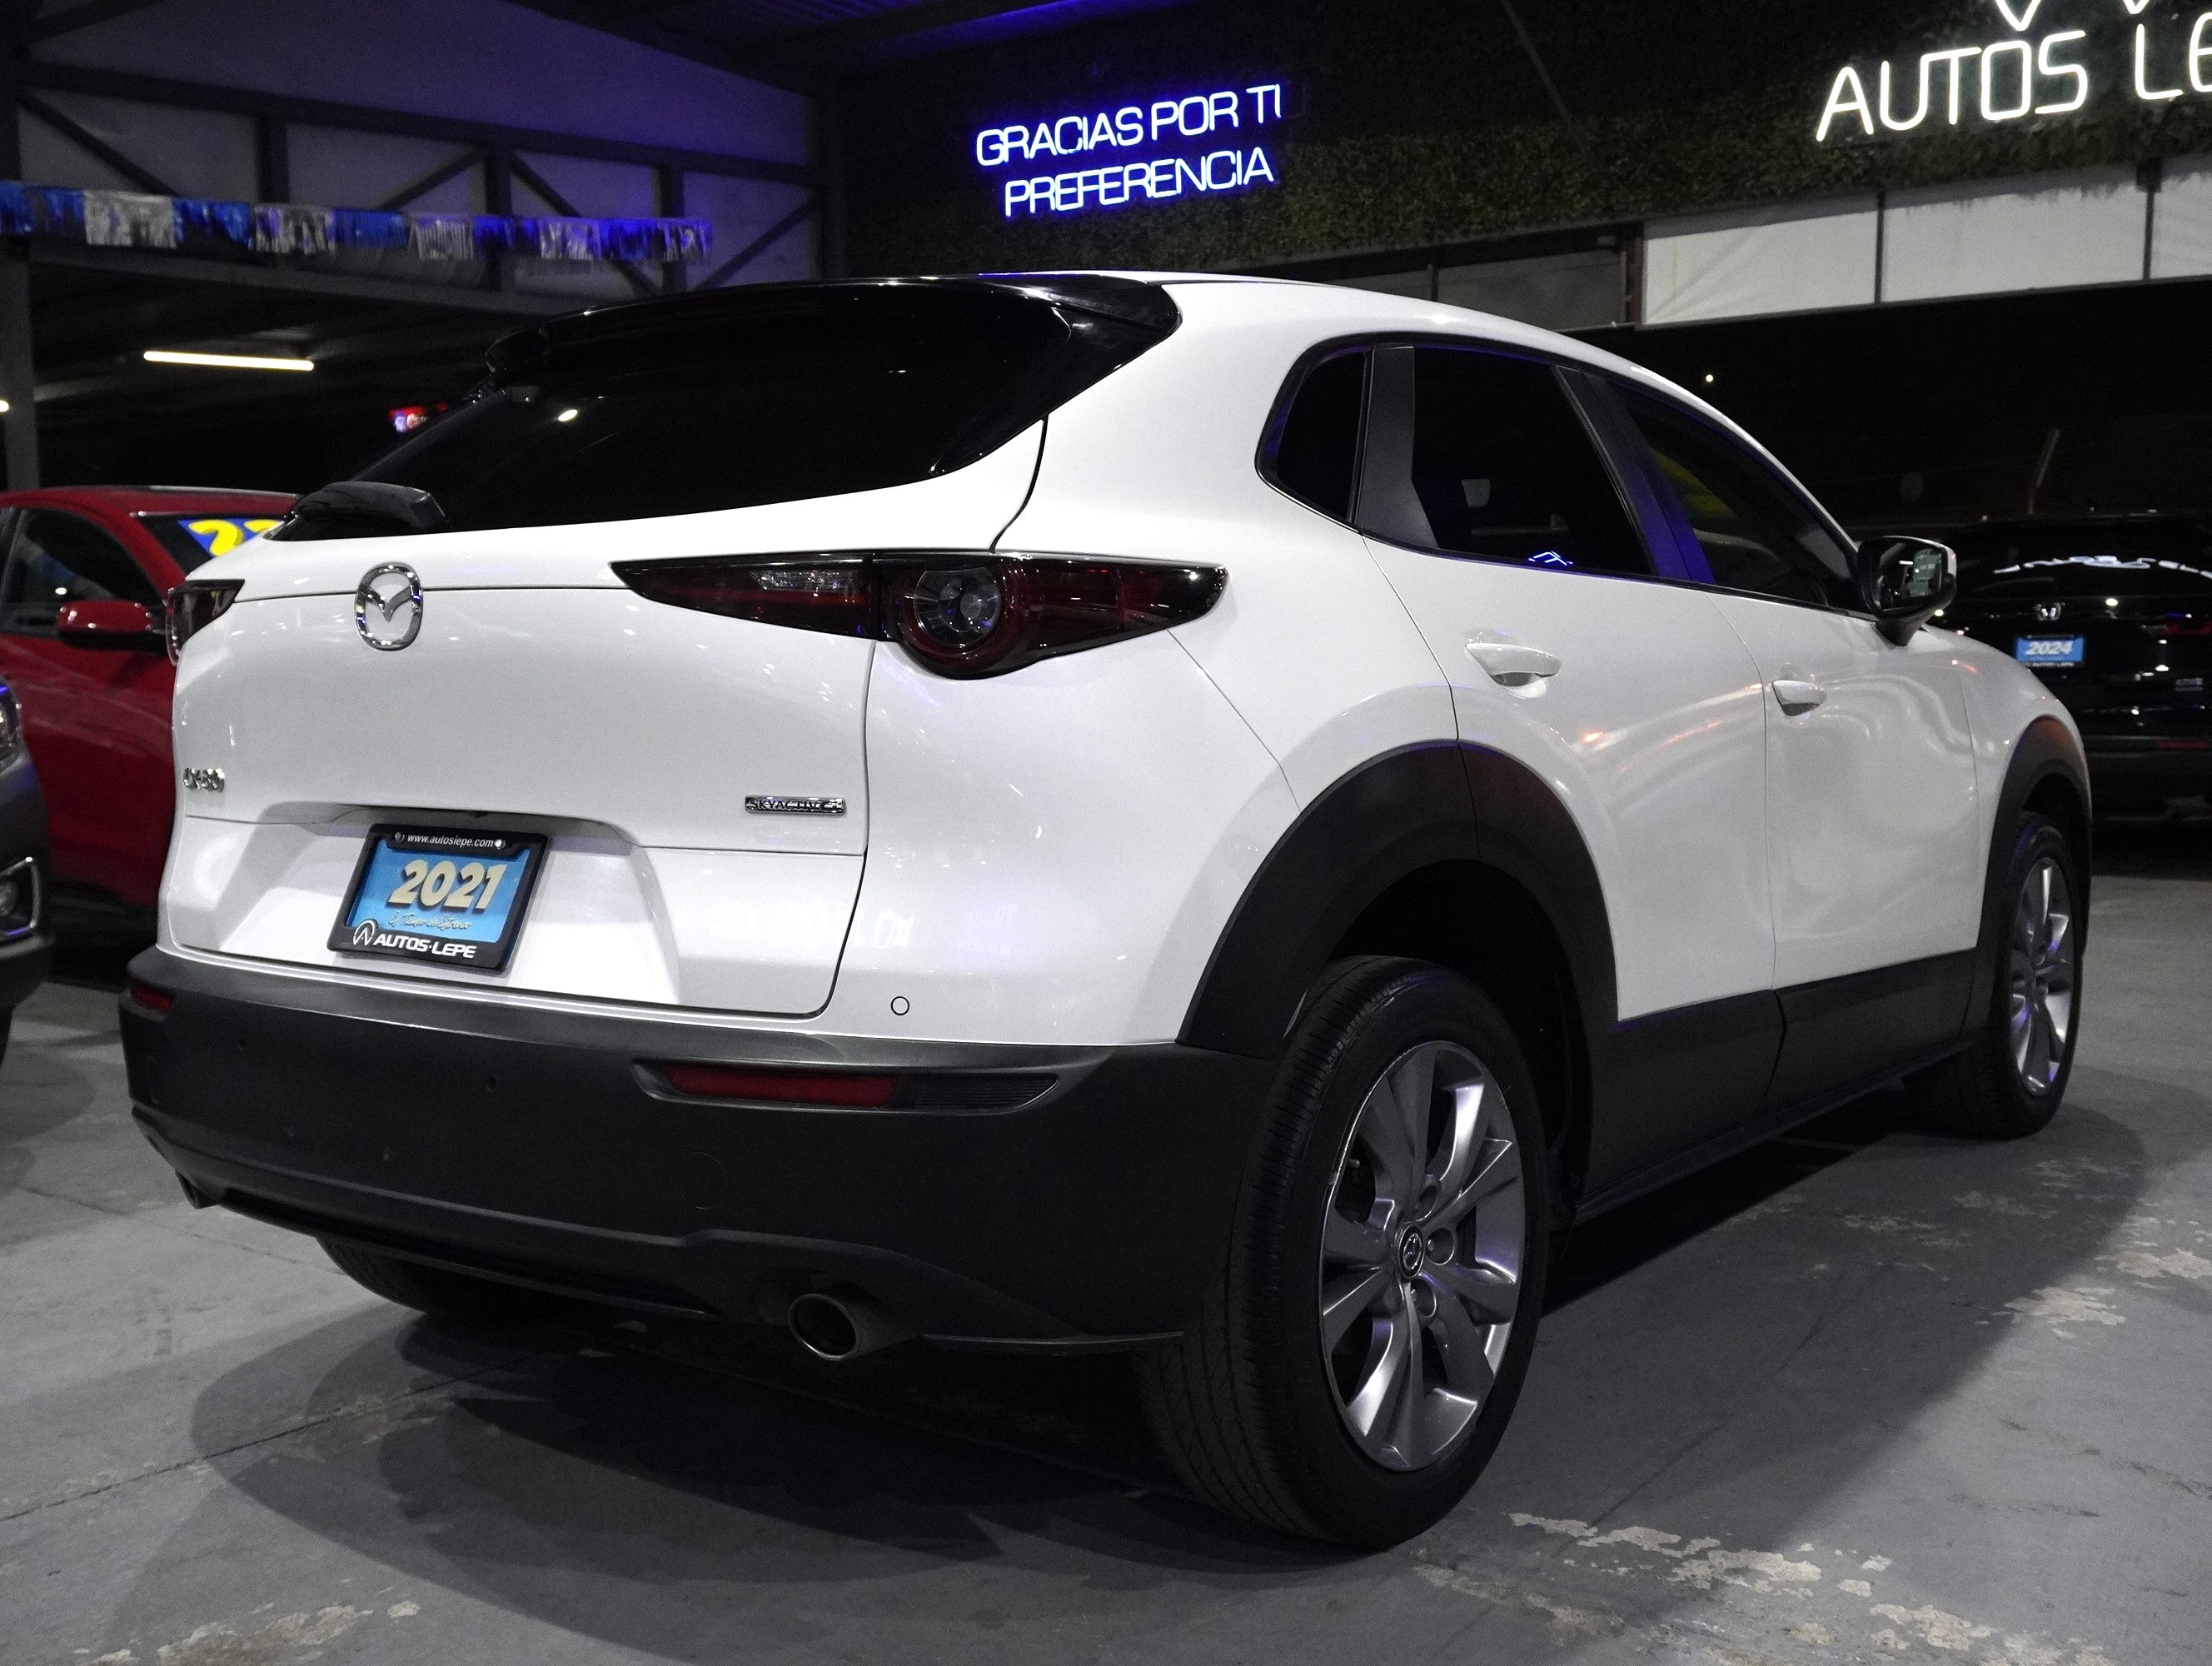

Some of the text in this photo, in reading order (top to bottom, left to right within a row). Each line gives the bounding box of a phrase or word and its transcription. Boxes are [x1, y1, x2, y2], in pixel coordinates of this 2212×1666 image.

[1816, 30, 2089, 142] AUTOS
[976, 83, 1283, 167] GRACIAS POR TI
[1004, 147, 1274, 217] PREFERENCIA
[2025, 641, 2074, 656] 2024
[407, 834, 494, 848] www.autoslepe.com
[387, 859, 507, 910] 2021
